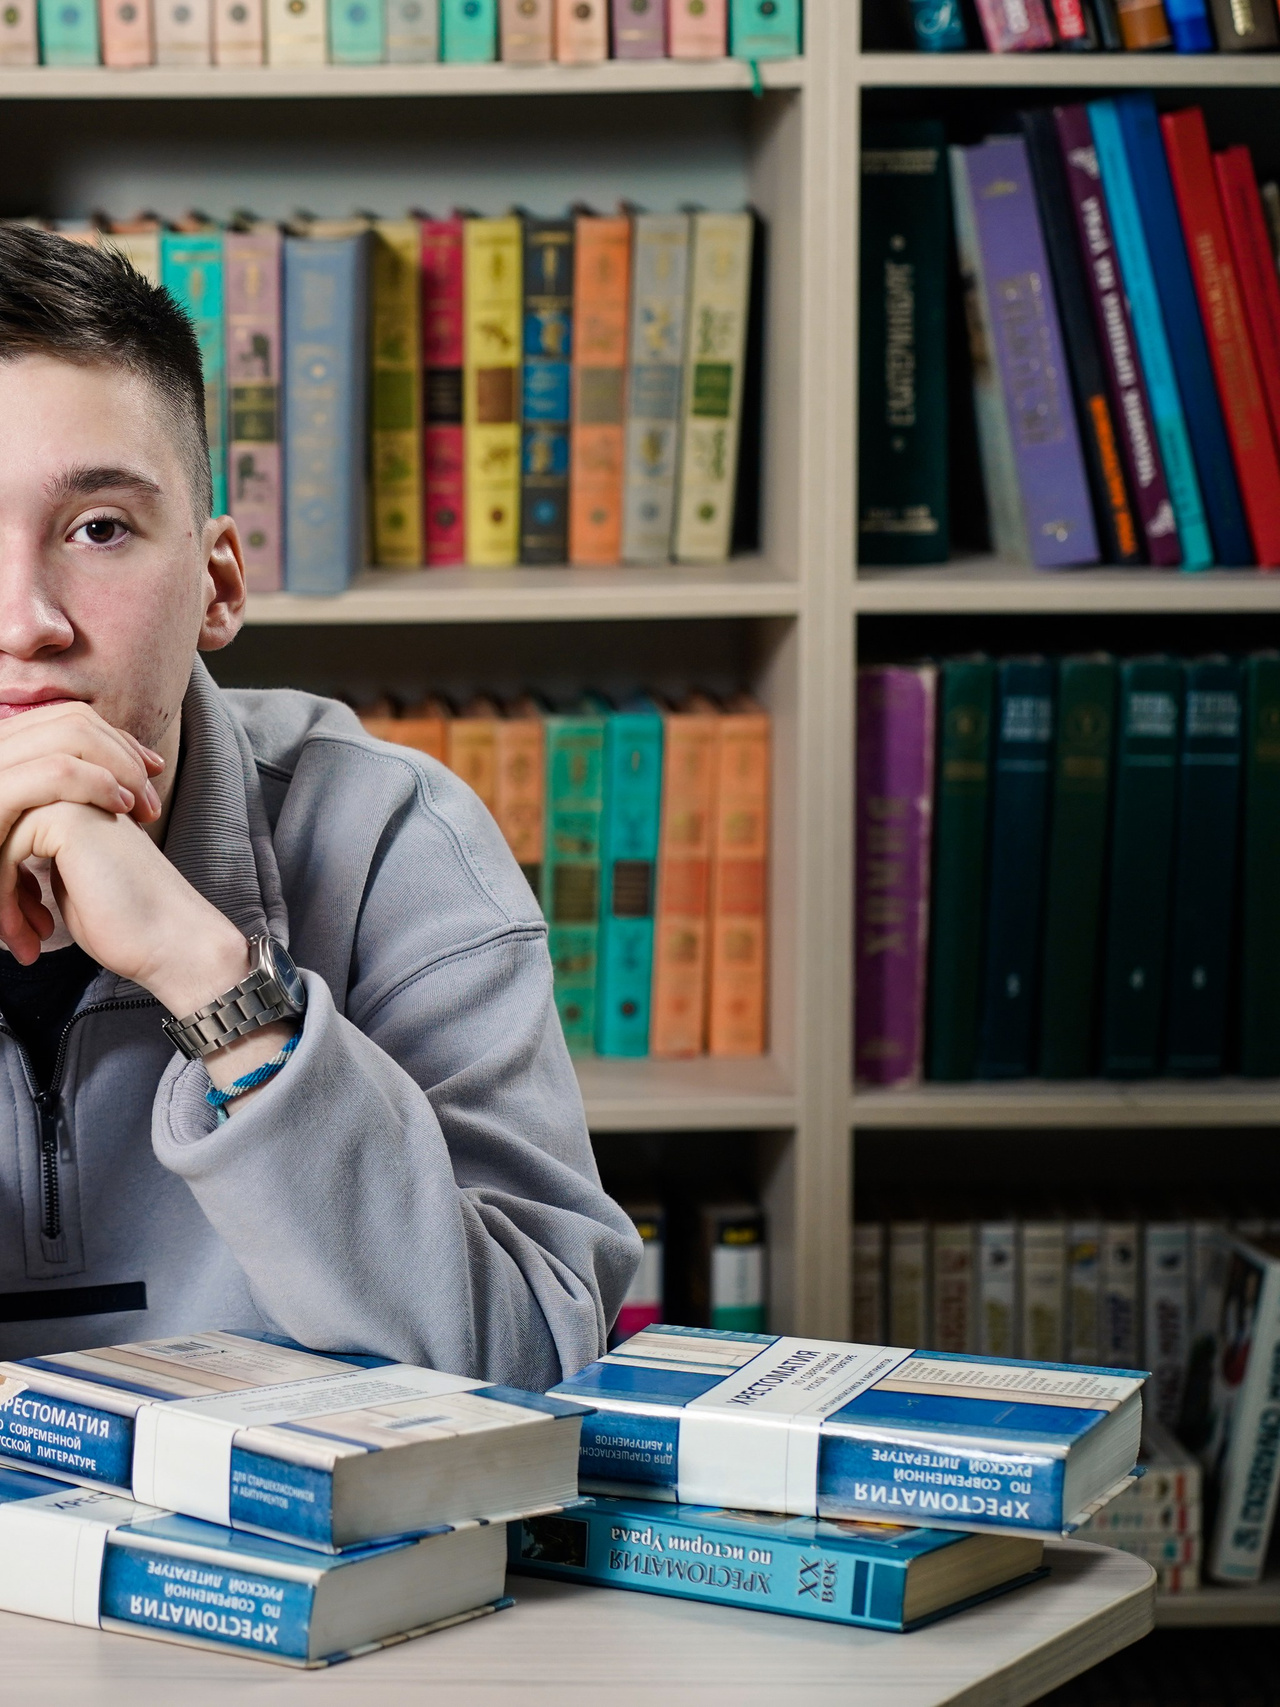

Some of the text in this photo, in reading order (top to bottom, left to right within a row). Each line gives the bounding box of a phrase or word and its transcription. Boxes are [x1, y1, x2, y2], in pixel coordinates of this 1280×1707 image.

[725, 1349, 822, 1407] ХРЕСТОМАТИЯ
[9, 1422, 81, 1451] СОВРЕМЕННОЙ
[594, 1435, 673, 1452] И АБИТУРИЕНТОВ
[37, 1445, 97, 1471] ЛИТЕРАТУРЕ
[654, 1453, 673, 1465] ДЛЯ
[871, 1448, 1033, 1478] РУССКОЙ ЛИТЕРАТУРЕ
[893, 1467, 1031, 1495] ПО СОВРЕМЕННОЙ
[853, 1482, 1030, 1520] ХРЕСТОМАТИЯ
[609, 1526, 772, 1565] по истории Урала
[147, 1560, 284, 1601] РУССКОЙ ЛИТЕРАТУРЕ
[607, 1548, 772, 1595] ХРЕСТОМАТИЯ
[164, 1582, 281, 1619] ПО СОВРЕМЕННОЙ
[129, 1595, 279, 1645] ХРЕСТОМАТИЯ
